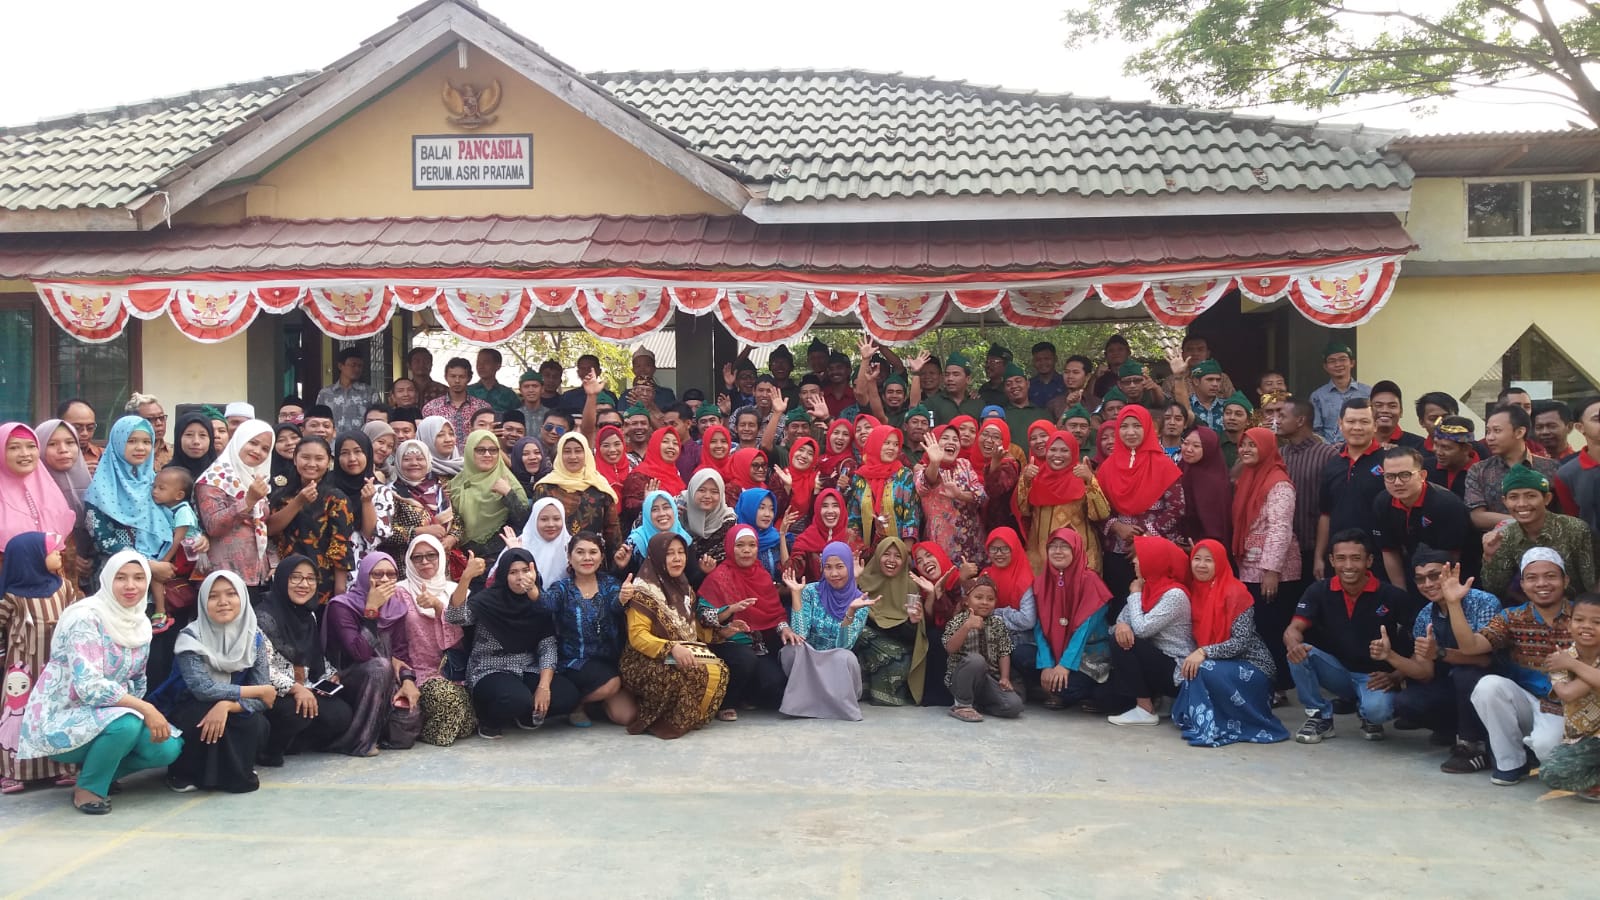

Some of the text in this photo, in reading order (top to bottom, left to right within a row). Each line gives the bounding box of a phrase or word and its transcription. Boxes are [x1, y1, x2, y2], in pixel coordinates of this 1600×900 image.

[421, 139, 523, 160] BALAI PANCASILA
[420, 164, 524, 180] PERUM. ASRI PRATAMA
